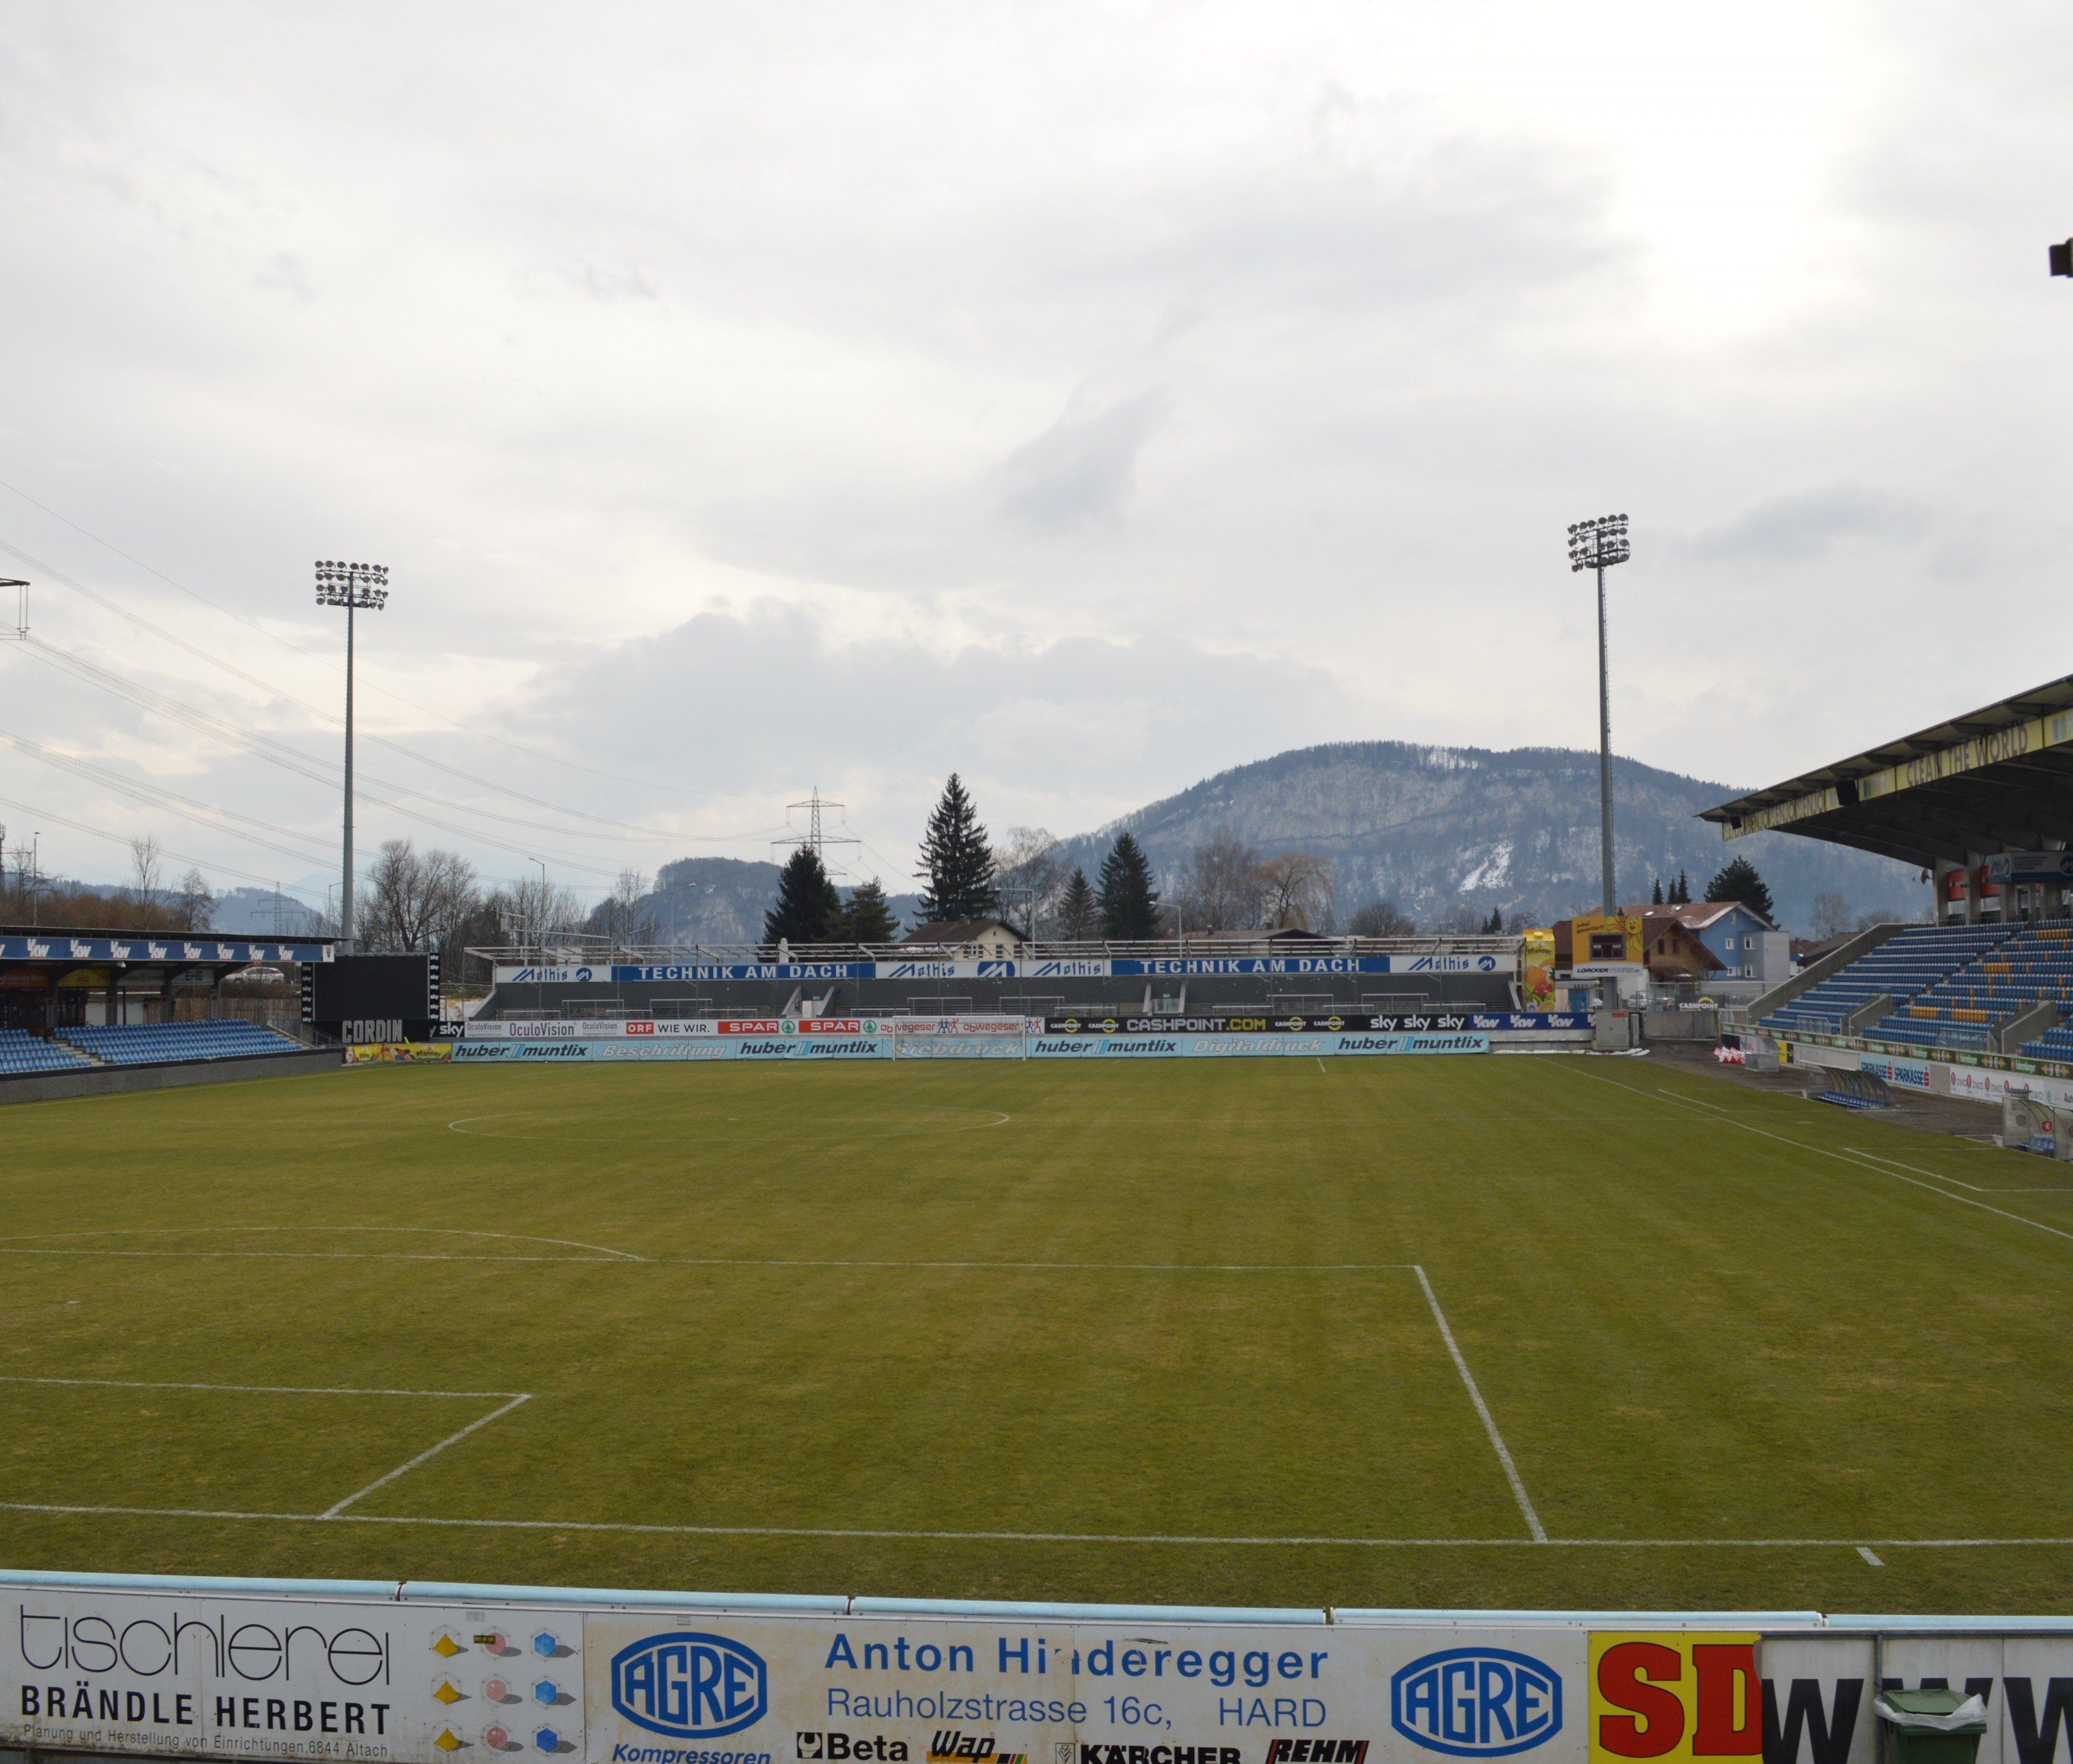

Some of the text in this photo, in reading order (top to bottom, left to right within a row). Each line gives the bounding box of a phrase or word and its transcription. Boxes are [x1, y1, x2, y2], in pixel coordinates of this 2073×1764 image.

[1907, 723, 2028, 786] CLEAN THE WORLD
[888, 963, 955, 978] Mathis
[1033, 961, 1100, 976] Mathis
[1140, 959, 1360, 974] TECHNIK AM DACH
[1408, 956, 1469, 970] Mathis
[512, 968, 567, 981] Mathis
[639, 965, 847, 979] TECHNIK AM DACH
[467, 1022, 501, 1031] OculoVision
[510, 1022, 574, 1037] OculoVision
[582, 1022, 617, 1030] OculoVision
[628, 1024, 710, 1033] ORF WIE WIR.
[729, 1023, 777, 1032] SPAR
[810, 1022, 858, 1031] SPAR
[880, 1024, 935, 1033] obwegeser
[963, 1023, 1018, 1033] obwegeser
[1127, 1018, 1266, 1031] CASHPOINT.COM
[1370, 1014, 1397, 1031] sky
[1404, 1014, 1430, 1030] sky
[1437, 1014, 1465, 1030] sky
[342, 1019, 402, 1044] CORDIN
[439, 1022, 464, 1038] sky
[740, 1041, 878, 1054] huber muntlix
[895, 1042, 1019, 1055] Siebdruck
[1035, 1040, 1176, 1052] huber muntlix
[1193, 1038, 1323, 1054] Digitaldruck
[1338, 1036, 1483, 1049] huber muntlix
[455, 1044, 588, 1057] huber muntlix
[602, 1044, 726, 1059] Beschriftung
[1894, 1066, 1923, 1086] SPARKASSE
[21, 1605, 389, 1685] tischlerei
[825, 1633, 974, 1671] Anton
[624, 1645, 755, 1726] AGRE
[22, 1680, 390, 1735] BRÄNDLE HERBERT
[828, 1688, 1326, 1730] Rauholzstrasse 16c, HARD
[1406, 1661, 1549, 1744] AGRE
[24, 1724, 73, 1743] Planung
[80, 1728, 102, 1741] und
[109, 1729, 179, 1748] Herstellung
[186, 1737, 208, 1748] von
[347, 1743, 388, 1757] Altach
[827, 1732, 908, 1761] Beta
[932, 1730, 996, 1763] Wap
[612, 1743, 771, 1764] Kompressoren
[1080, 1744, 1241, 1764] KÄRCHER
[1270, 1739, 1366, 1763] REHM
